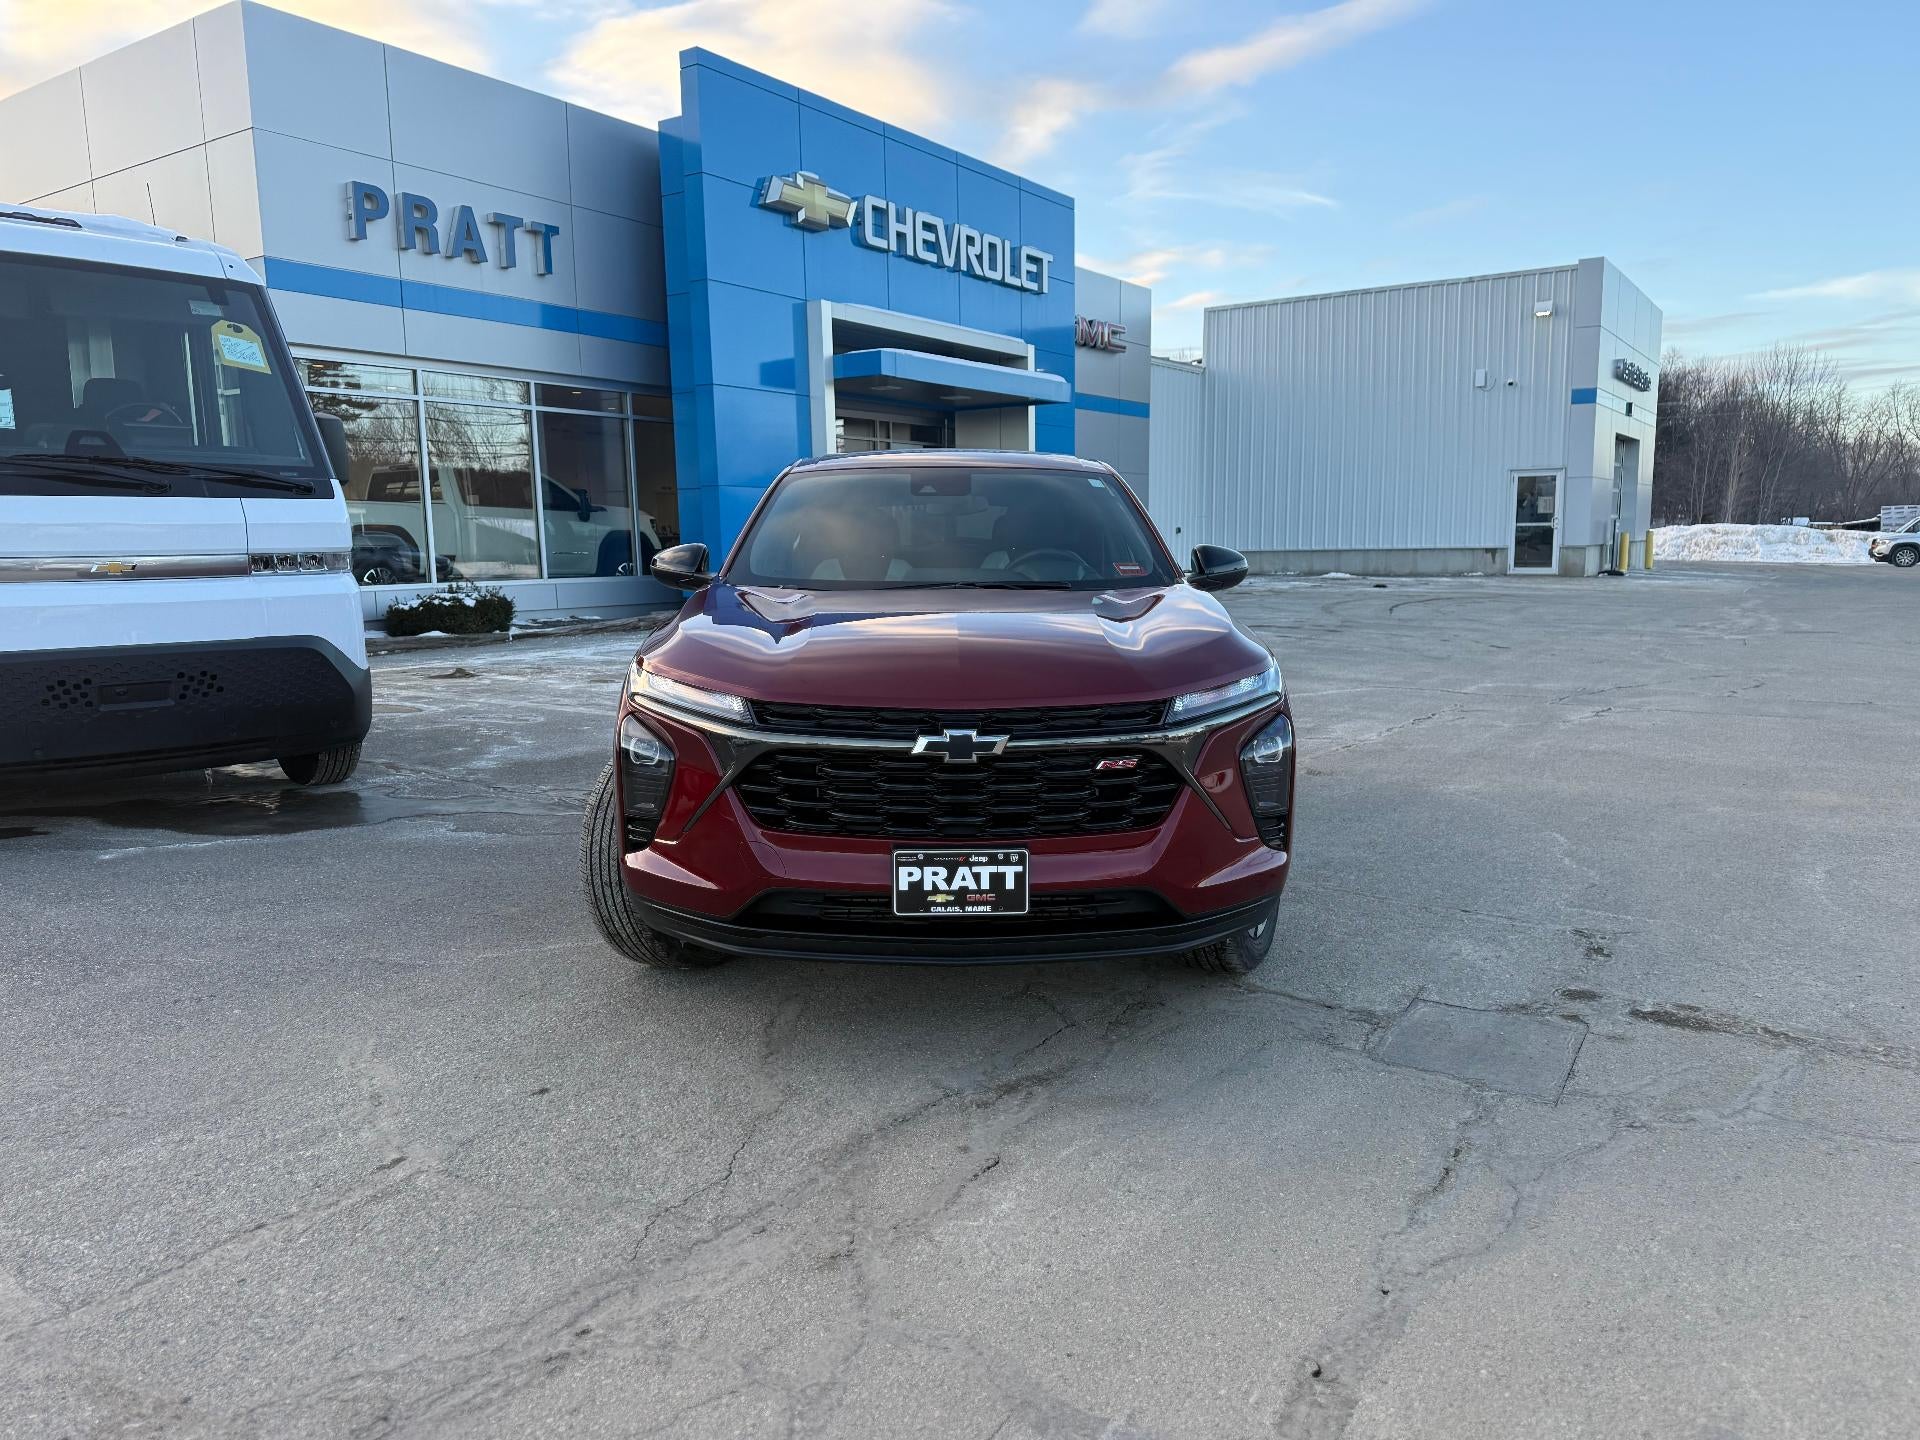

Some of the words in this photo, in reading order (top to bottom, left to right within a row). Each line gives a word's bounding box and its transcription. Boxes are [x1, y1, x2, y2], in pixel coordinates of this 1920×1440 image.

[345, 181, 560, 276] PRATT
[862, 194, 1053, 295] CHEVROLET
[1096, 759, 1138, 770] RS
[969, 854, 988, 863] Jeep
[898, 866, 1023, 891] PRATT
[966, 893, 996, 902] GMC
[931, 905, 963, 913] CALAIS,
